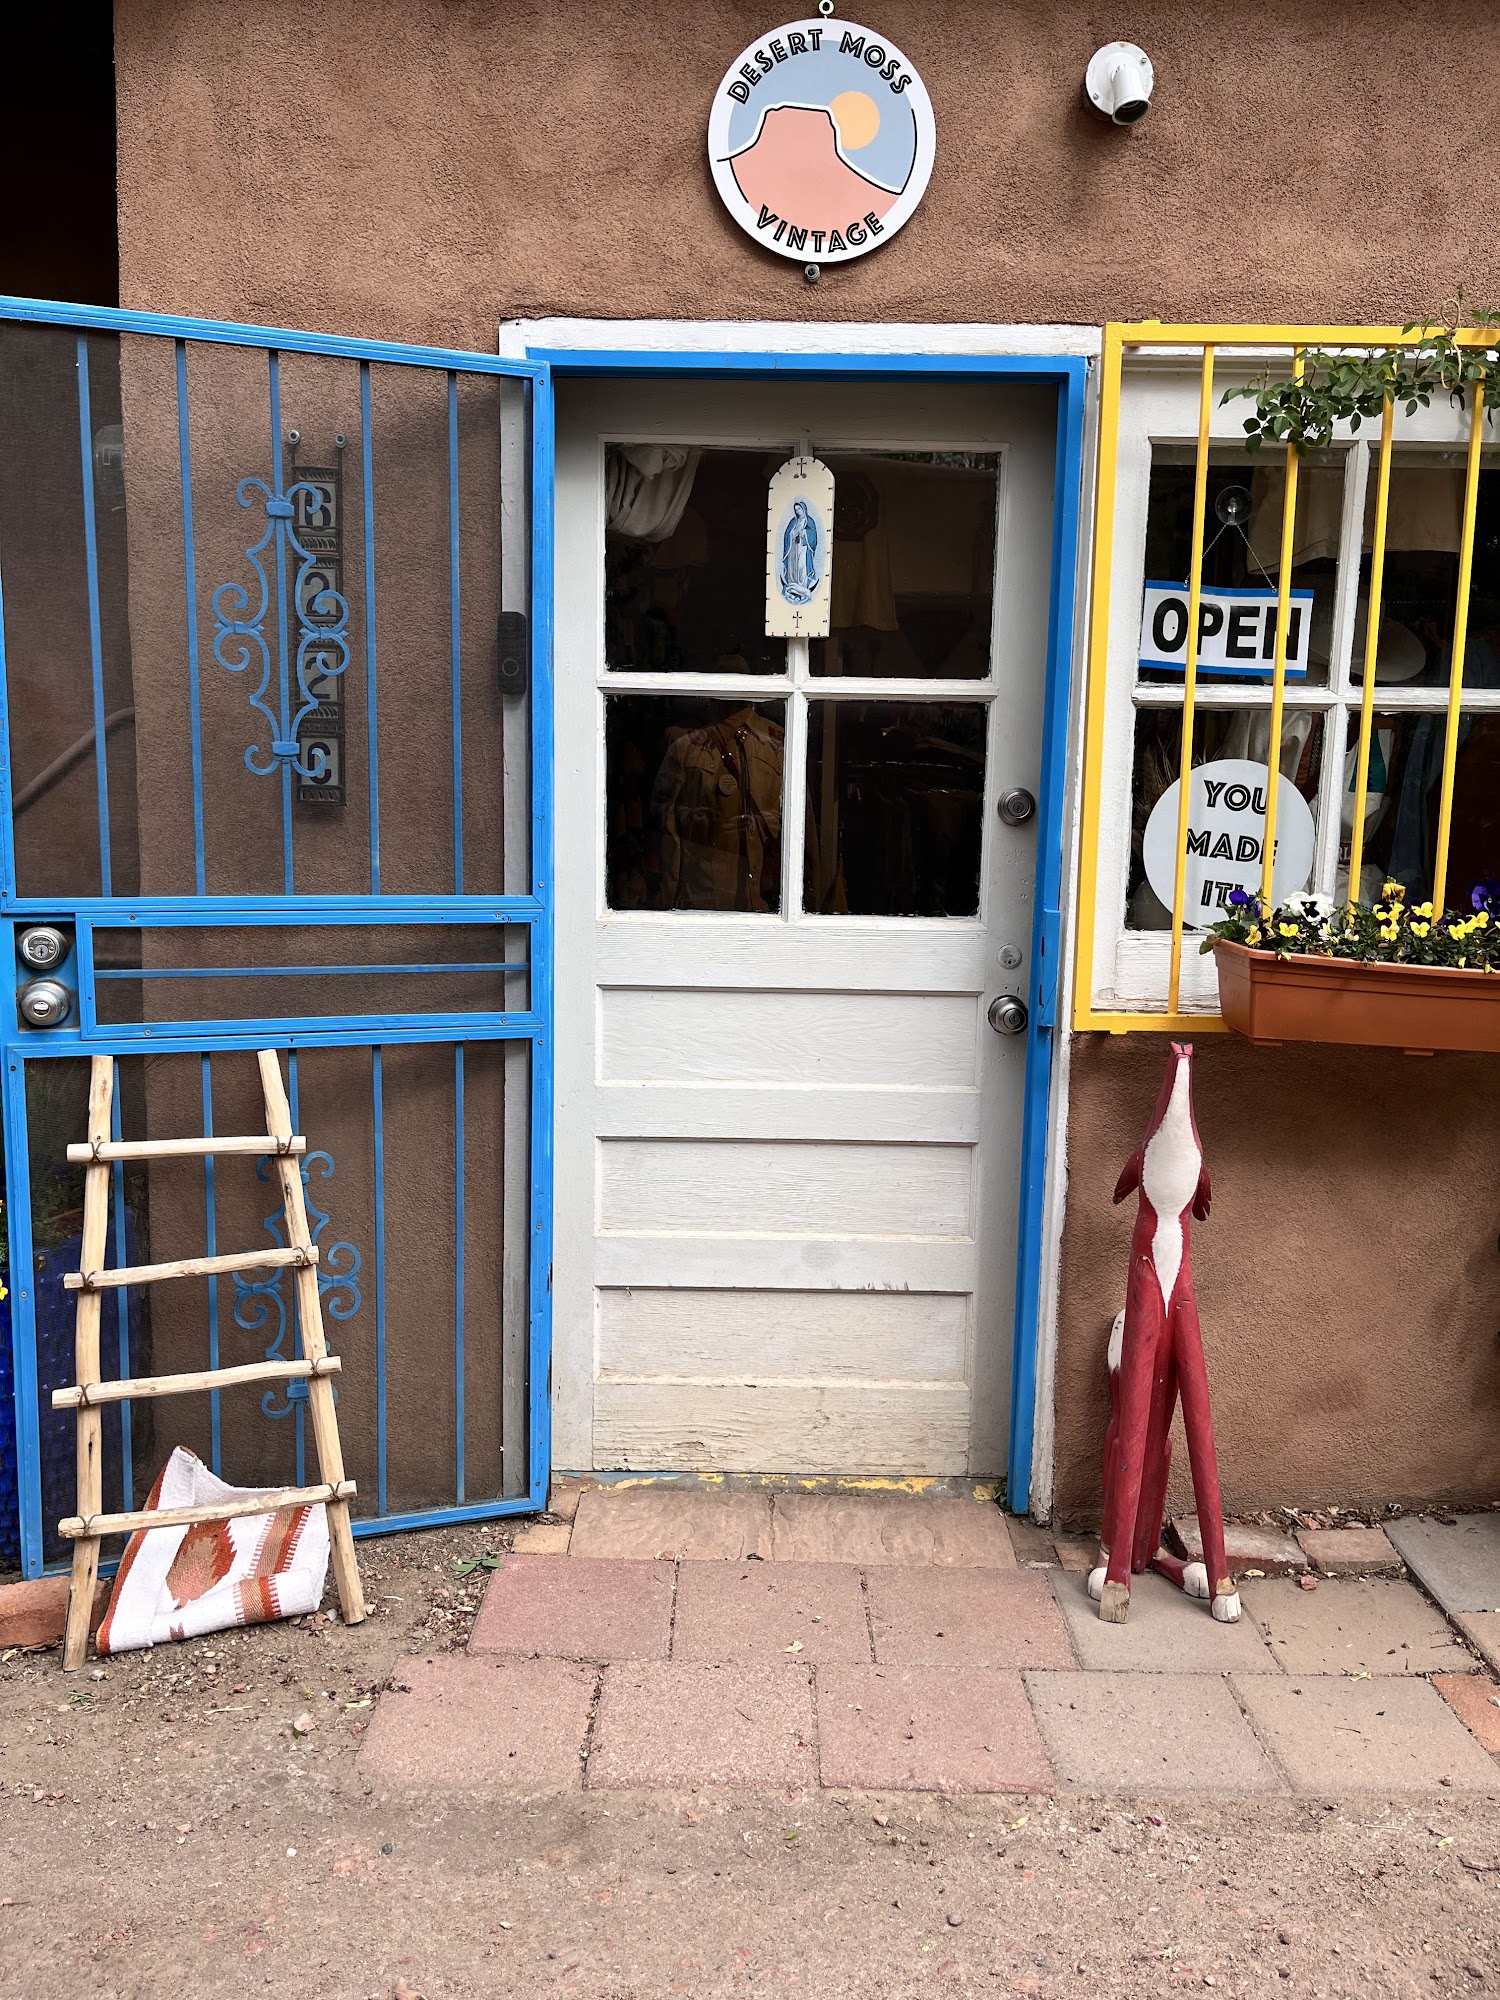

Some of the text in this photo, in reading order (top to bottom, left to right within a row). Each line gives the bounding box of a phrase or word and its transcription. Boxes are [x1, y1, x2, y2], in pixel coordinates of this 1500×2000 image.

[727, 28, 912, 105] DESERT MOSS
[756, 204, 884, 253] VINTAGE
[1152, 597, 1302, 661] OPEN
[1203, 780, 1268, 816] YOU
[1200, 879, 1244, 909] IT
